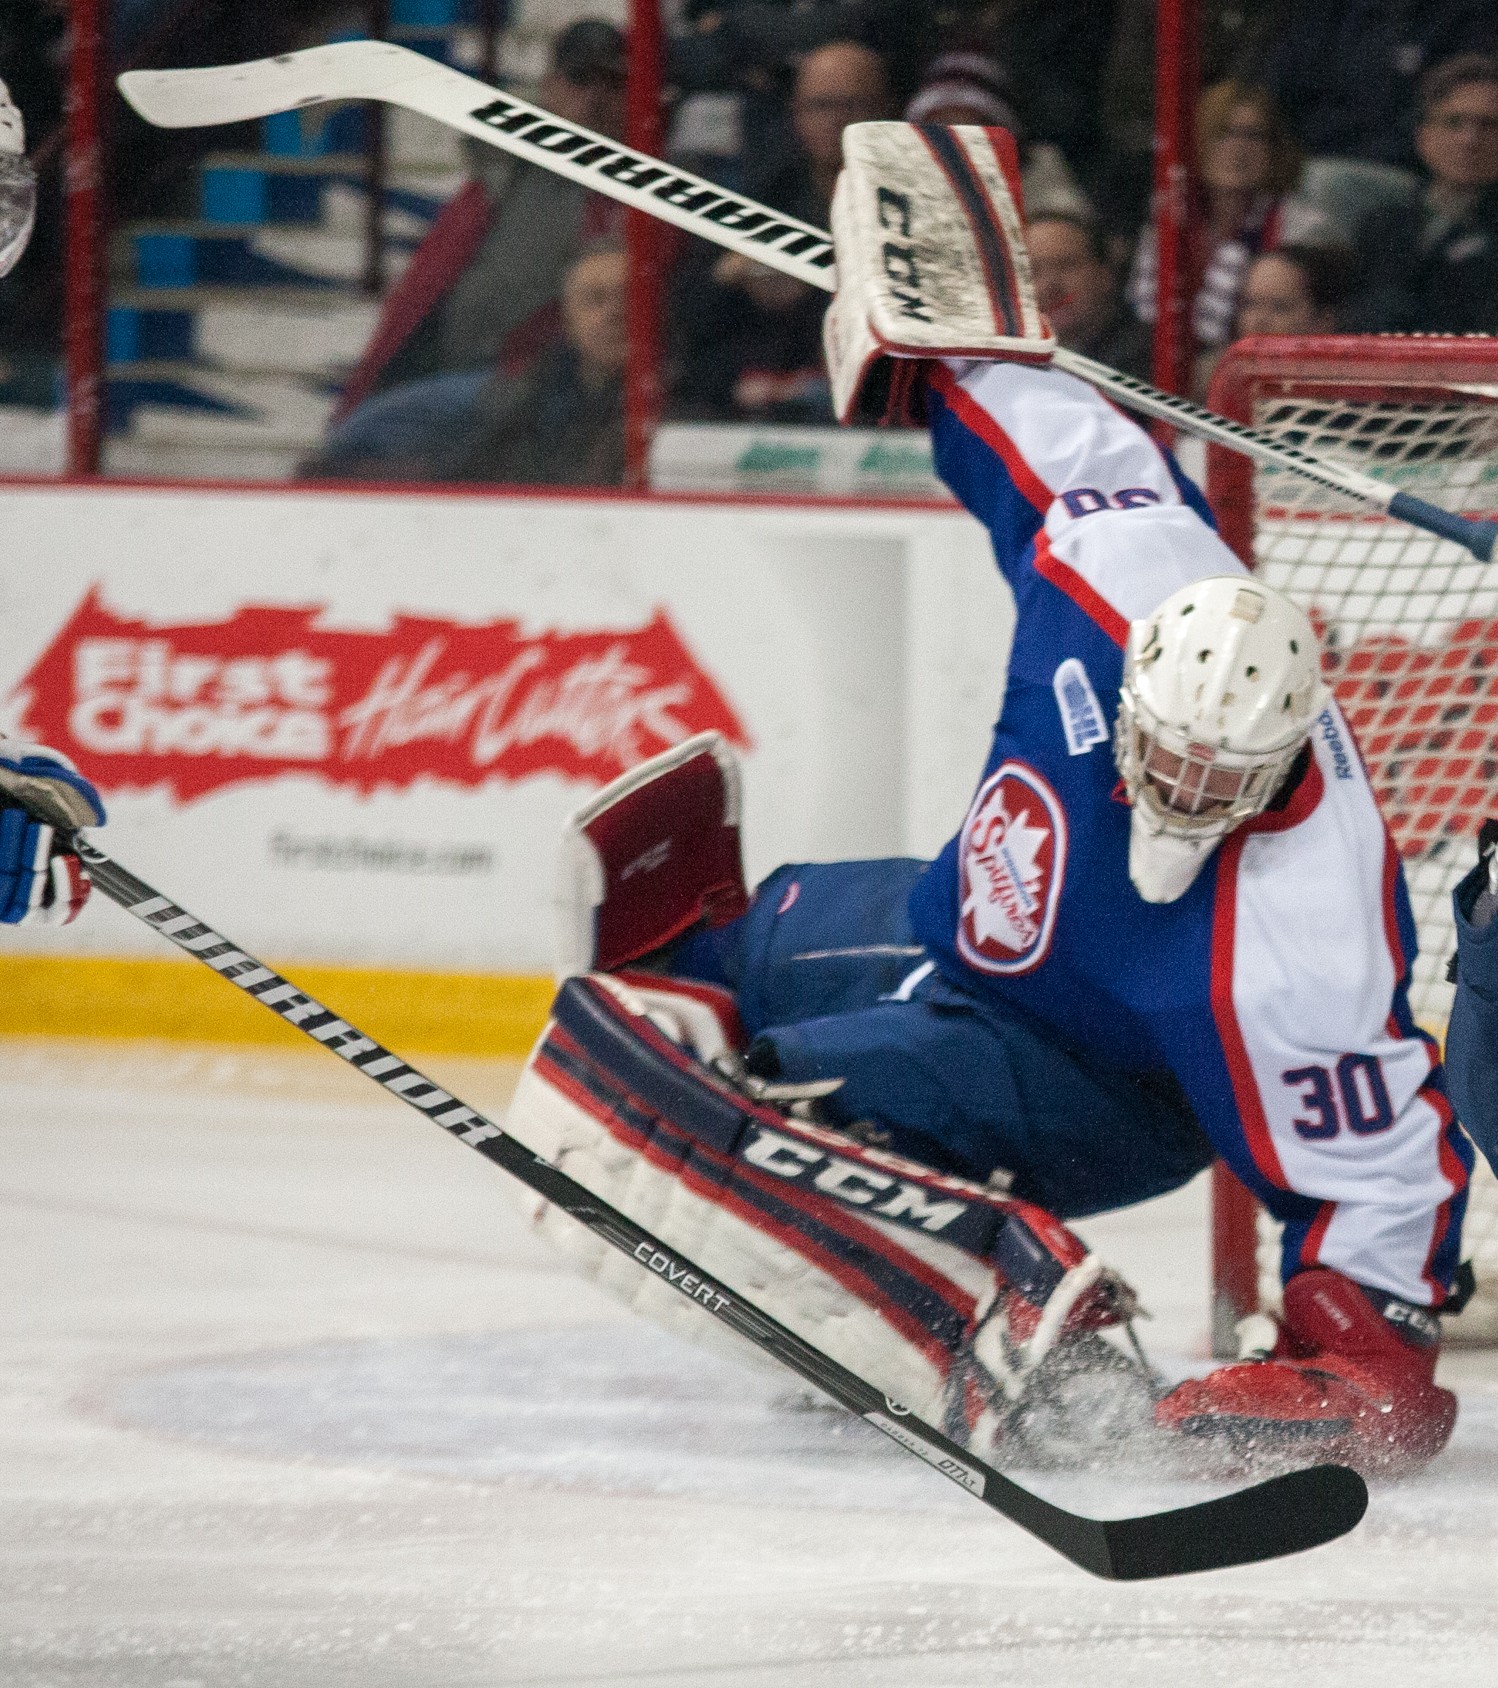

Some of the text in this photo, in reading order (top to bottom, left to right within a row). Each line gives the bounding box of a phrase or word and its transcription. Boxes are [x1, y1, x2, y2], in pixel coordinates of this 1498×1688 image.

[469, 98, 835, 270] WARRIOR
[73, 636, 332, 705] First
[68, 702, 332, 759] Choice
[131, 895, 503, 1149] WARRIOR
[1282, 1051, 1395, 1141] 30
[744, 1127, 969, 1233] CCM
[633, 1240, 731, 1313] COVERT
